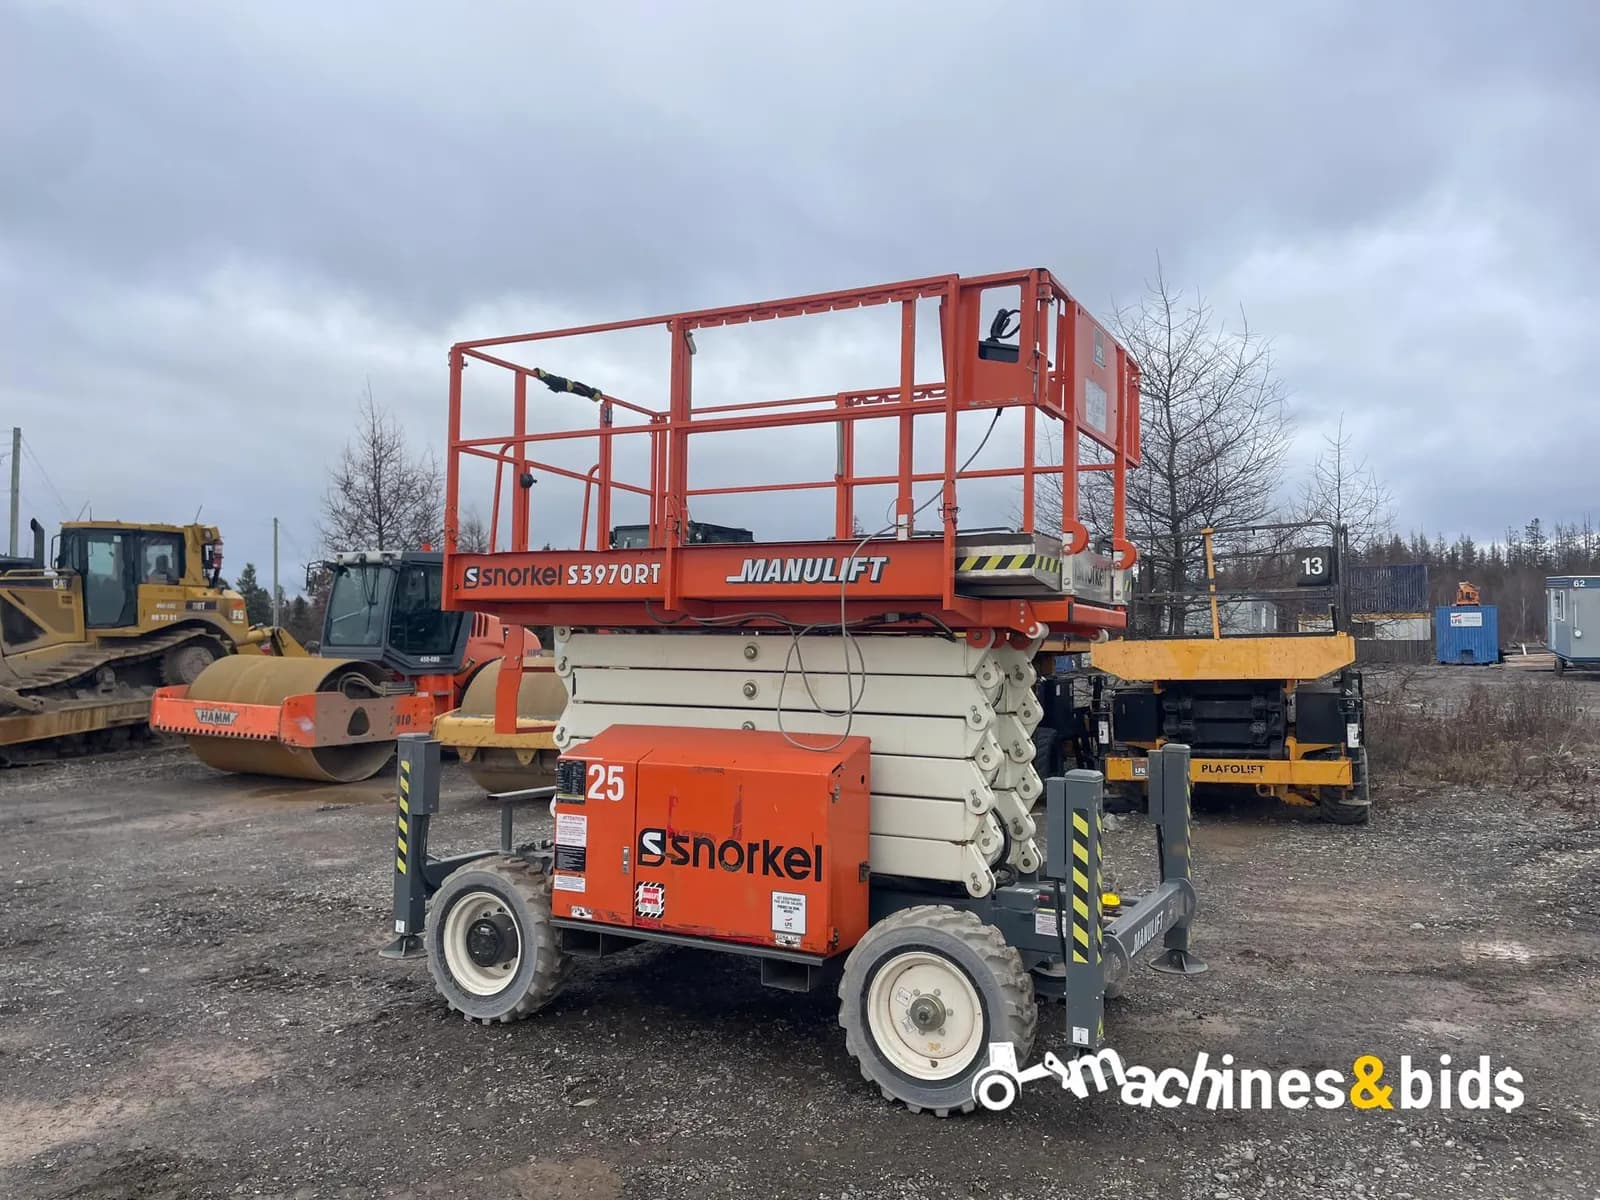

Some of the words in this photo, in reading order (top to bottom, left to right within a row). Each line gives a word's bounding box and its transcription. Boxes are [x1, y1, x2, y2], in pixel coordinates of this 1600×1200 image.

[481, 564, 563, 586] snorkel
[567, 563, 661, 585] S3970RT
[726, 556, 890, 583] MANULIFT
[1301, 557, 1323, 575] 13
[1573, 579, 1585, 588] 62
[200, 711, 232, 724] HAMM
[588, 765, 625, 801] 25
[671, 835, 823, 882] snorkel
[1130, 910, 1164, 958] MANULIFT
